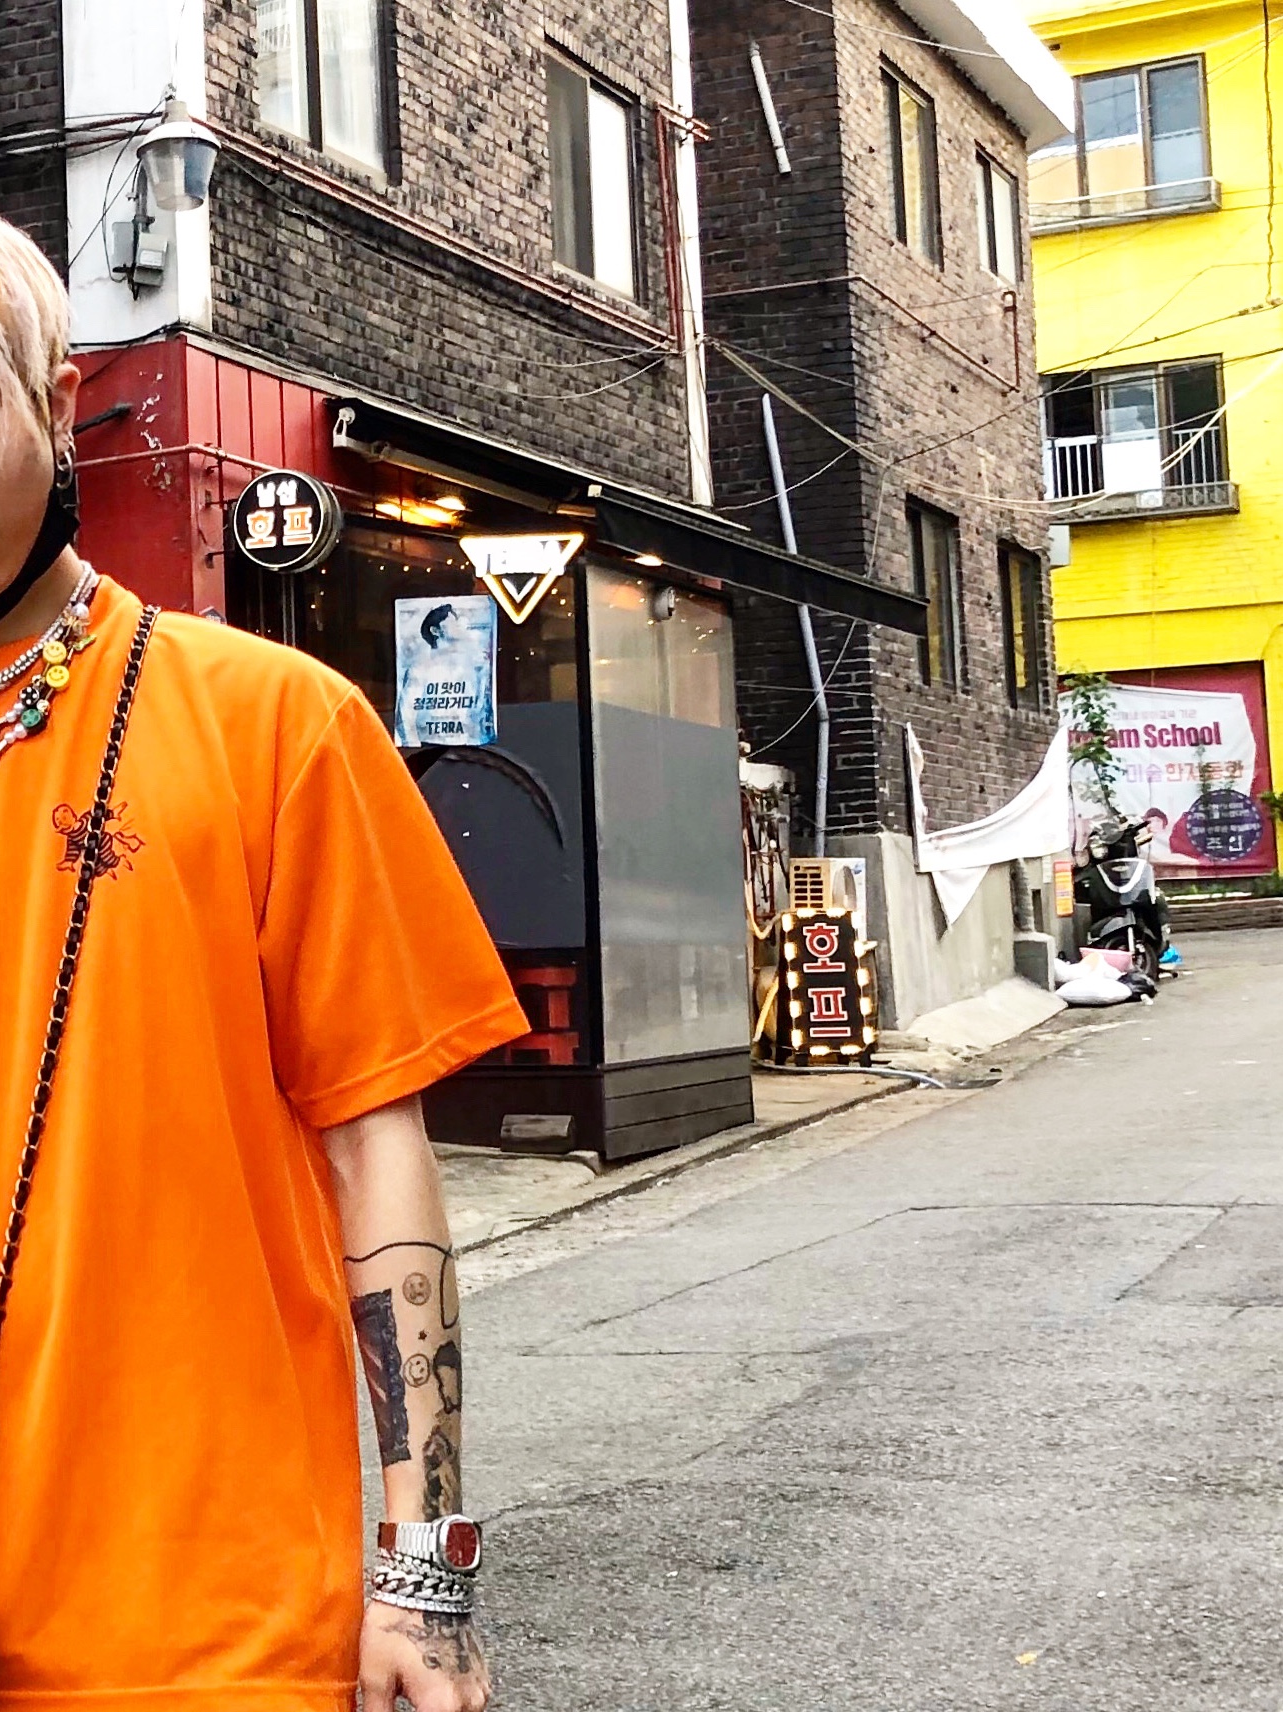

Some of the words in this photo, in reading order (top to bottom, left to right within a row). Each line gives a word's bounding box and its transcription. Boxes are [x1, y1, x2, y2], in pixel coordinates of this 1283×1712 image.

[245, 506, 314, 550] 호프
[426, 682, 439, 695] 이
[441, 681, 466, 695] 맛이
[413, 696, 479, 711] 청정라거다!
[425, 721, 464, 735] TERRA
[1144, 721, 1222, 749] School
[802, 922, 852, 1038] 호프
